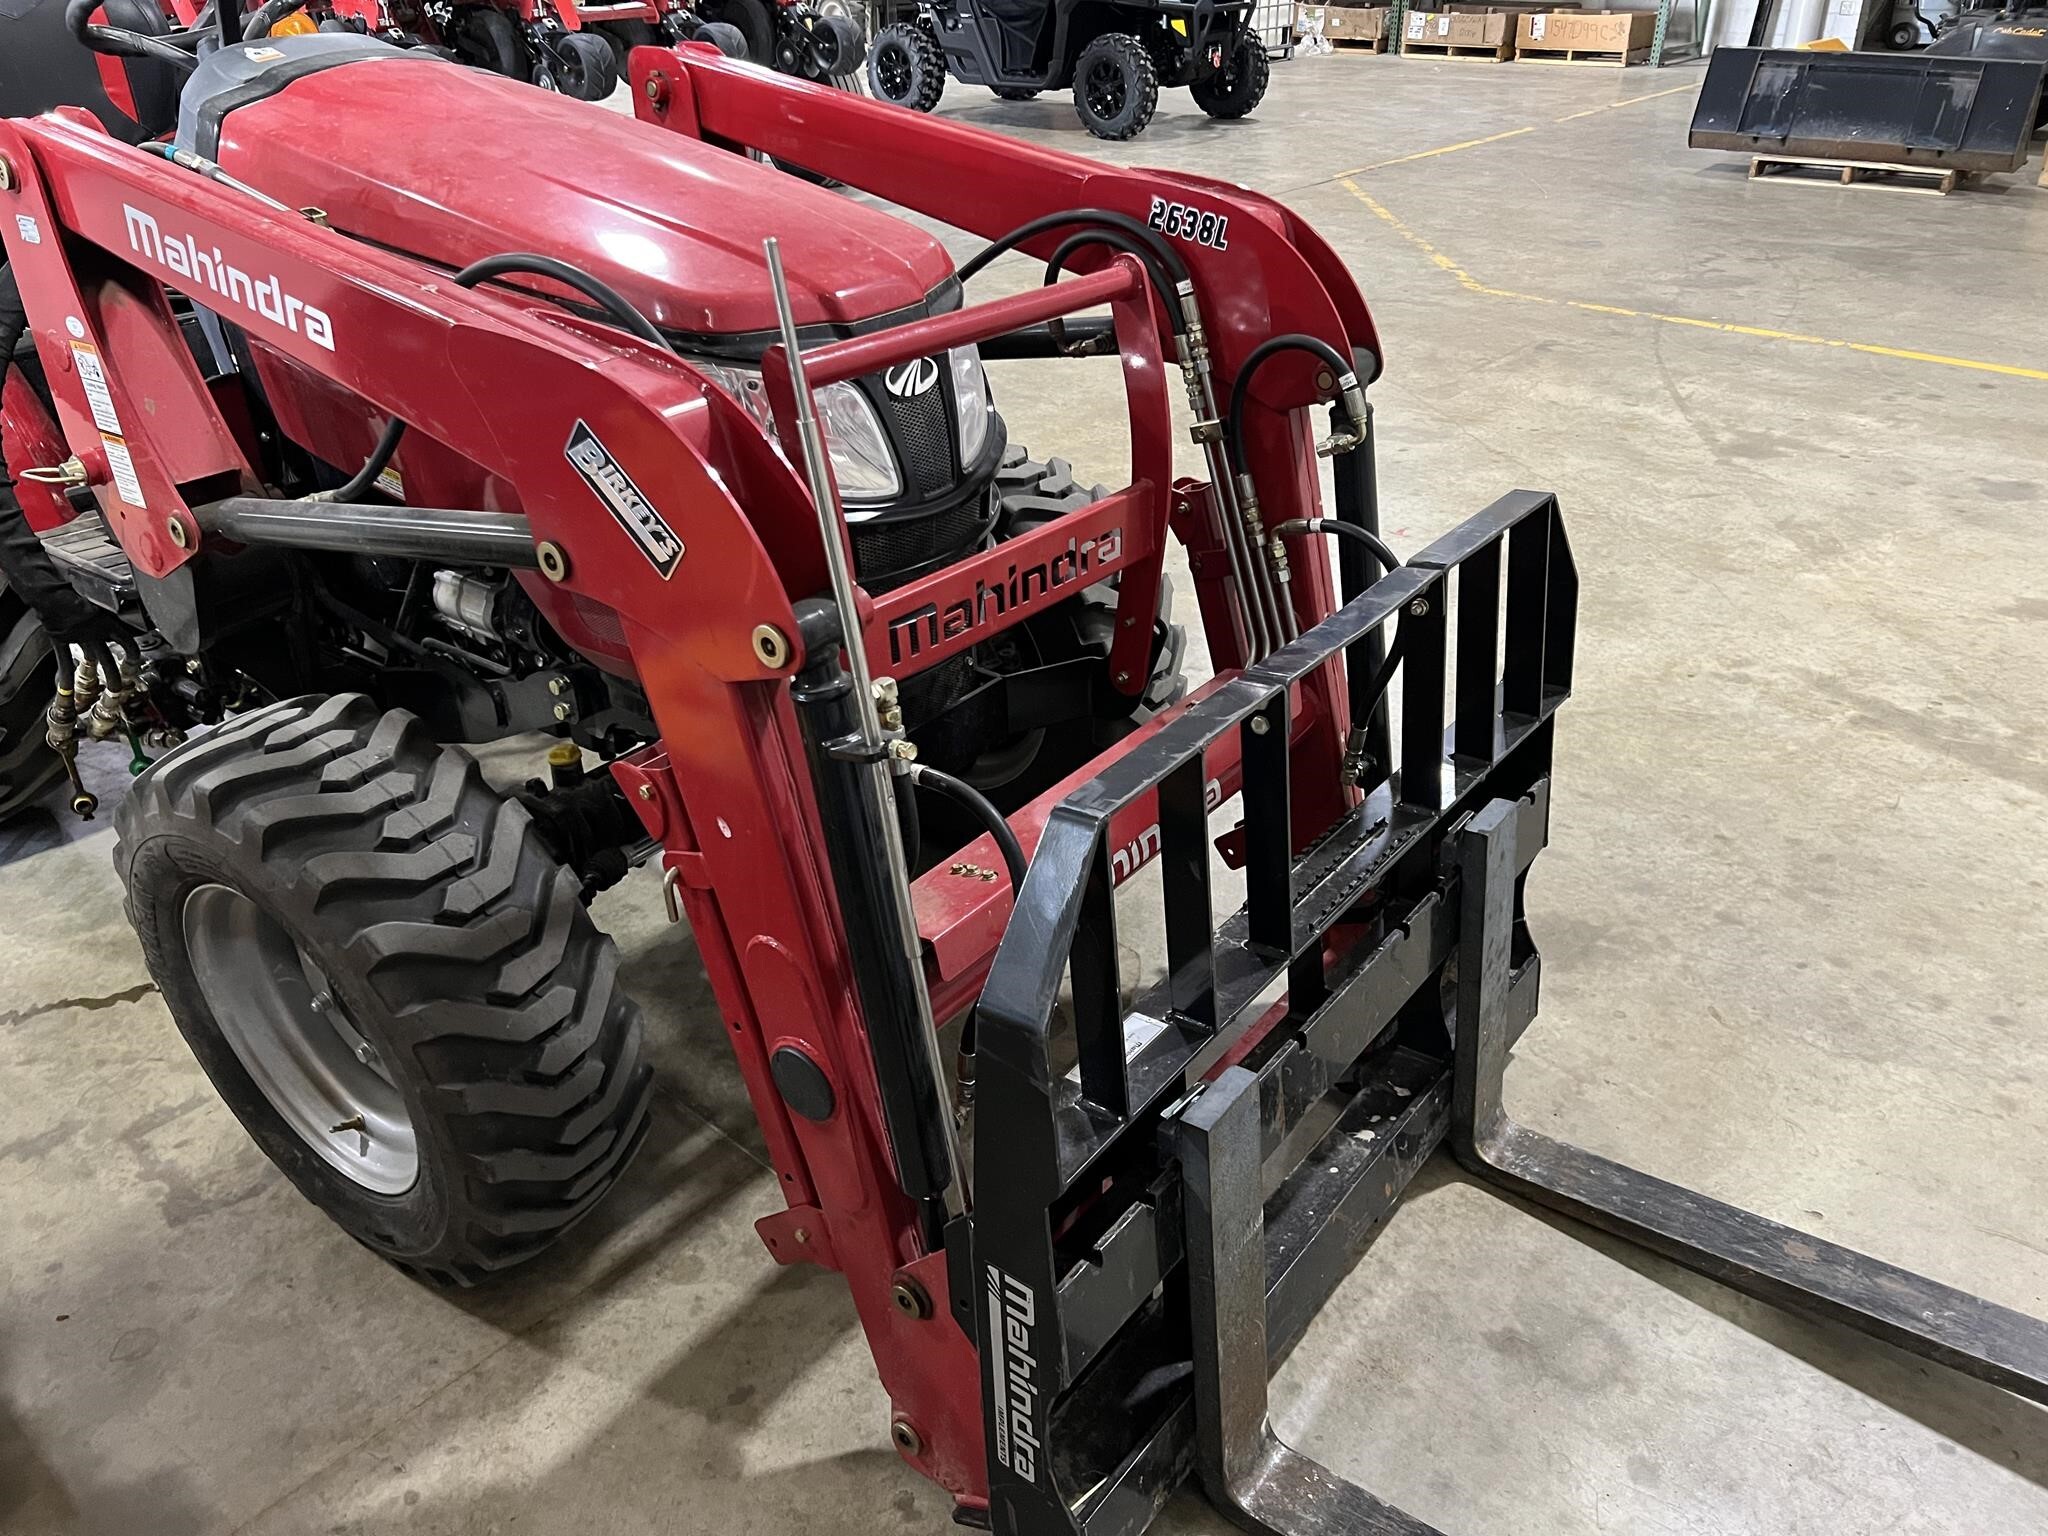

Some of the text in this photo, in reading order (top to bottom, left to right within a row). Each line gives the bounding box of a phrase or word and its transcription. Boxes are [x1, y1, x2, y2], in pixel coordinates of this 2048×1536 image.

[123, 203, 335, 352] Mahindra
[1148, 197, 1228, 251] 2638L
[567, 438, 680, 557] BIRKEY'S
[888, 527, 1123, 667] Mahindra
[998, 1404, 1008, 1464] IMPLEMENTS
[1003, 1274, 1041, 1484] Mahindra
